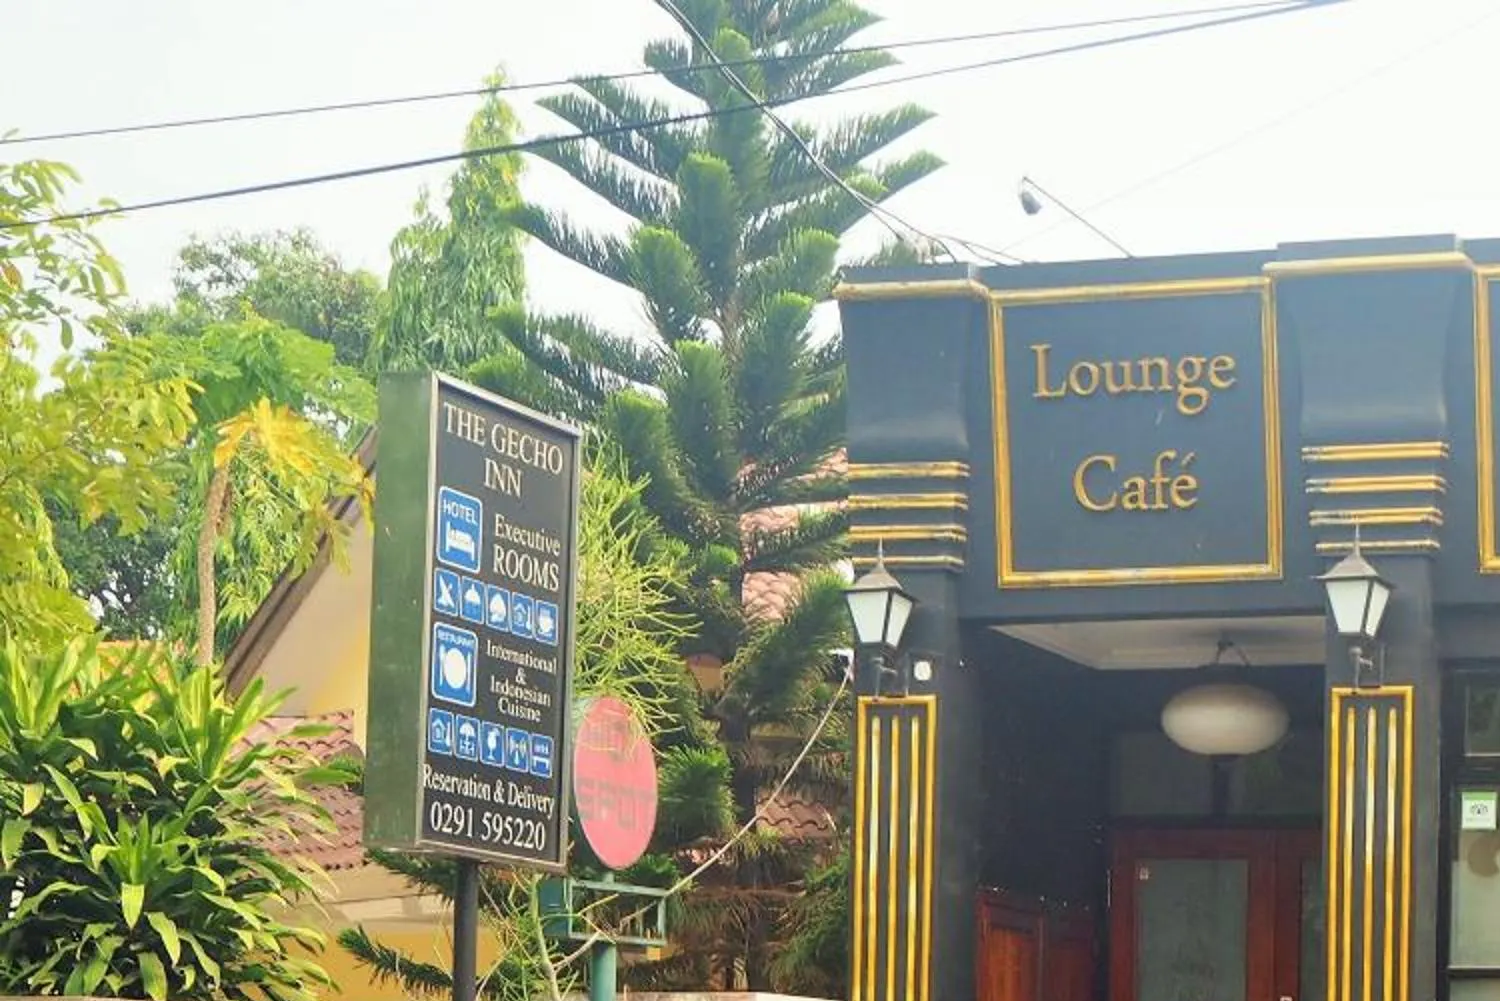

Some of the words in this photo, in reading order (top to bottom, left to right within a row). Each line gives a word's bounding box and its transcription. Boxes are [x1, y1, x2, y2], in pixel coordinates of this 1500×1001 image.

[1030, 343, 1237, 415] Lounge
[443, 402, 487, 447] THE
[491, 423, 563, 475] GECHO
[484, 457, 523, 498] INN
[1073, 450, 1199, 511] Café
[443, 499, 478, 526] HOTEL
[495, 513, 561, 556] Executive
[493, 544, 560, 593] ROOMS
[486, 639, 557, 676] International
[515, 667, 527, 684] &
[489, 675, 551, 708] Indonesian
[497, 697, 541, 722] Cuisine
[422, 763, 491, 801] Reservation
[493, 779, 504, 804] &
[507, 782, 556, 820] Delivery
[430, 800, 473, 839] 0291
[481, 811, 546, 851] 595220
